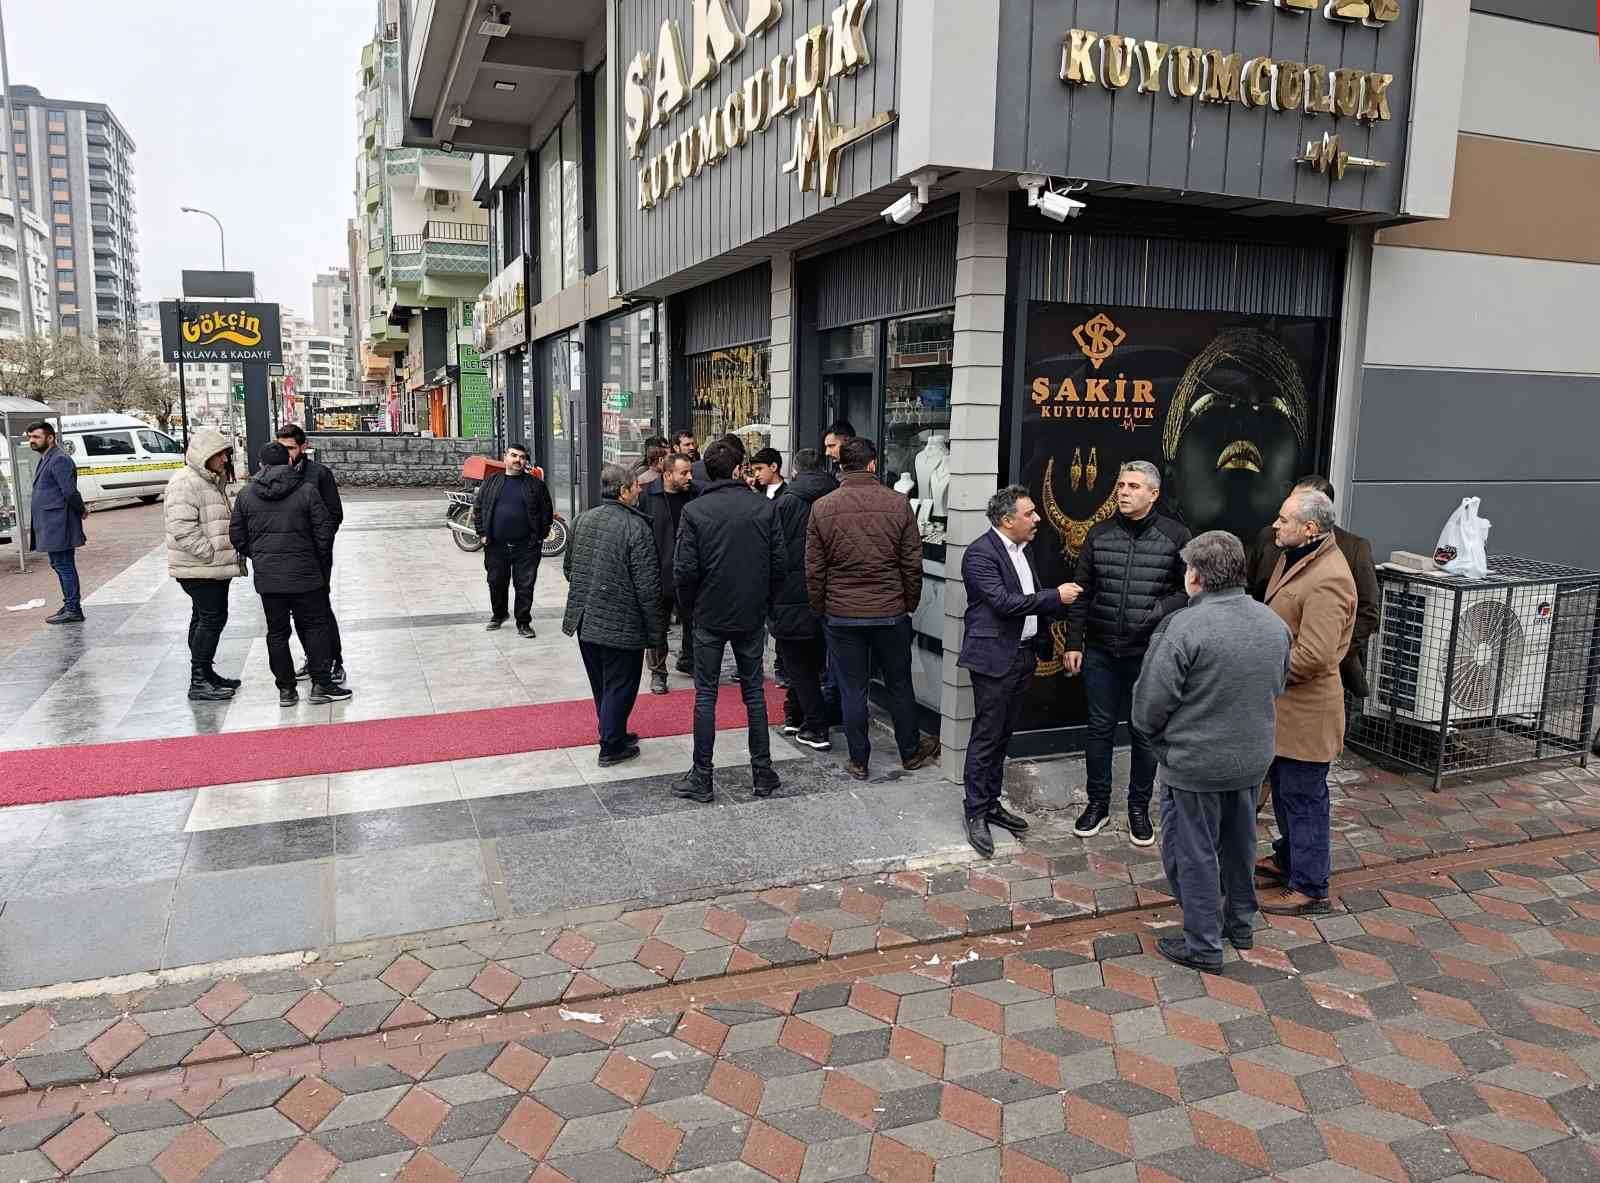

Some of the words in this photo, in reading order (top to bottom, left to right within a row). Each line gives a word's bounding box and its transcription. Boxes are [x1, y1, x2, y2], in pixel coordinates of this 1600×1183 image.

[1059, 28, 1393, 121] KUYUMCULUK
[638, 0, 871, 209] KUYUMCULUK
[182, 310, 261, 346] Gökçin
[1031, 372, 1156, 405] ŞAKİR
[1041, 405, 1154, 418] KUYUMCULUK
